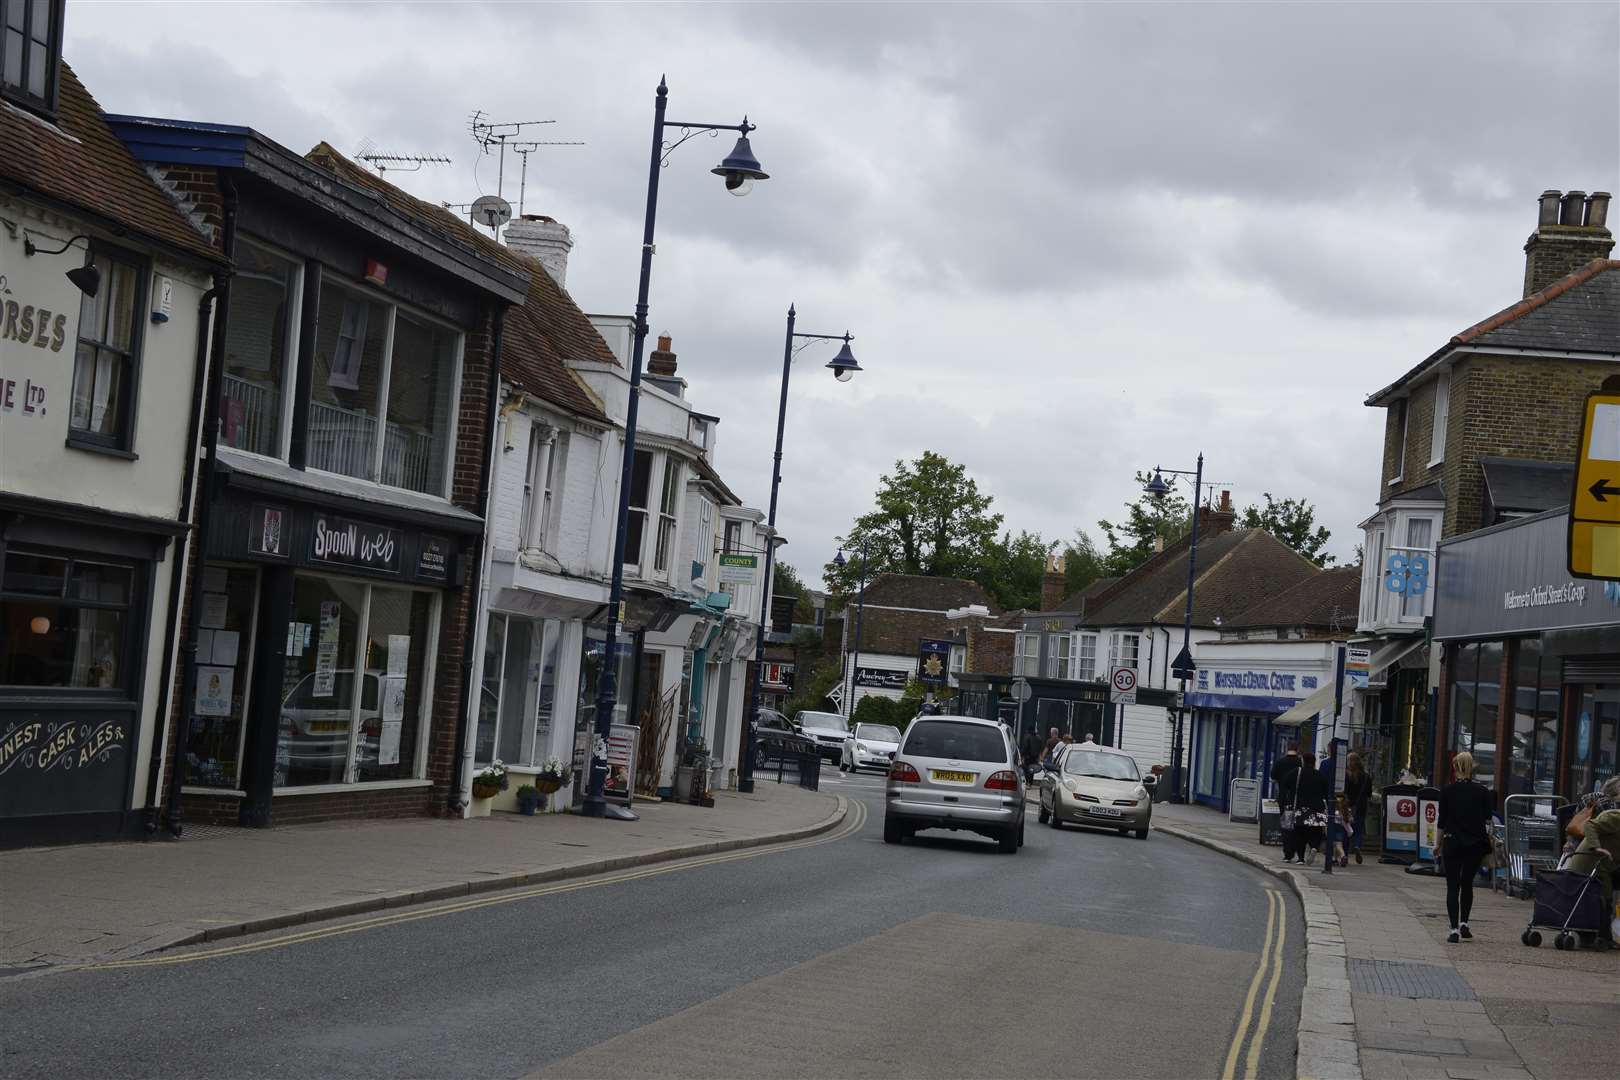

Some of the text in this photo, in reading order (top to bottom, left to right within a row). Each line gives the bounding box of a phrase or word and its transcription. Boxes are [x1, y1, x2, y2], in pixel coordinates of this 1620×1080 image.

[0, 298, 66, 352] RSES
[361, 529, 394, 562] web
[724, 557, 753, 565] COUNTY
[1531, 586, 1549, 607] Oxford
[1568, 582, 1585, 606] Co-op
[1117, 675, 1132, 685] 30
[38, 728, 76, 768] CASK
[78, 725, 113, 767] ALES
[1400, 802, 1413, 813] £1
[1427, 807, 1435, 819] £2
